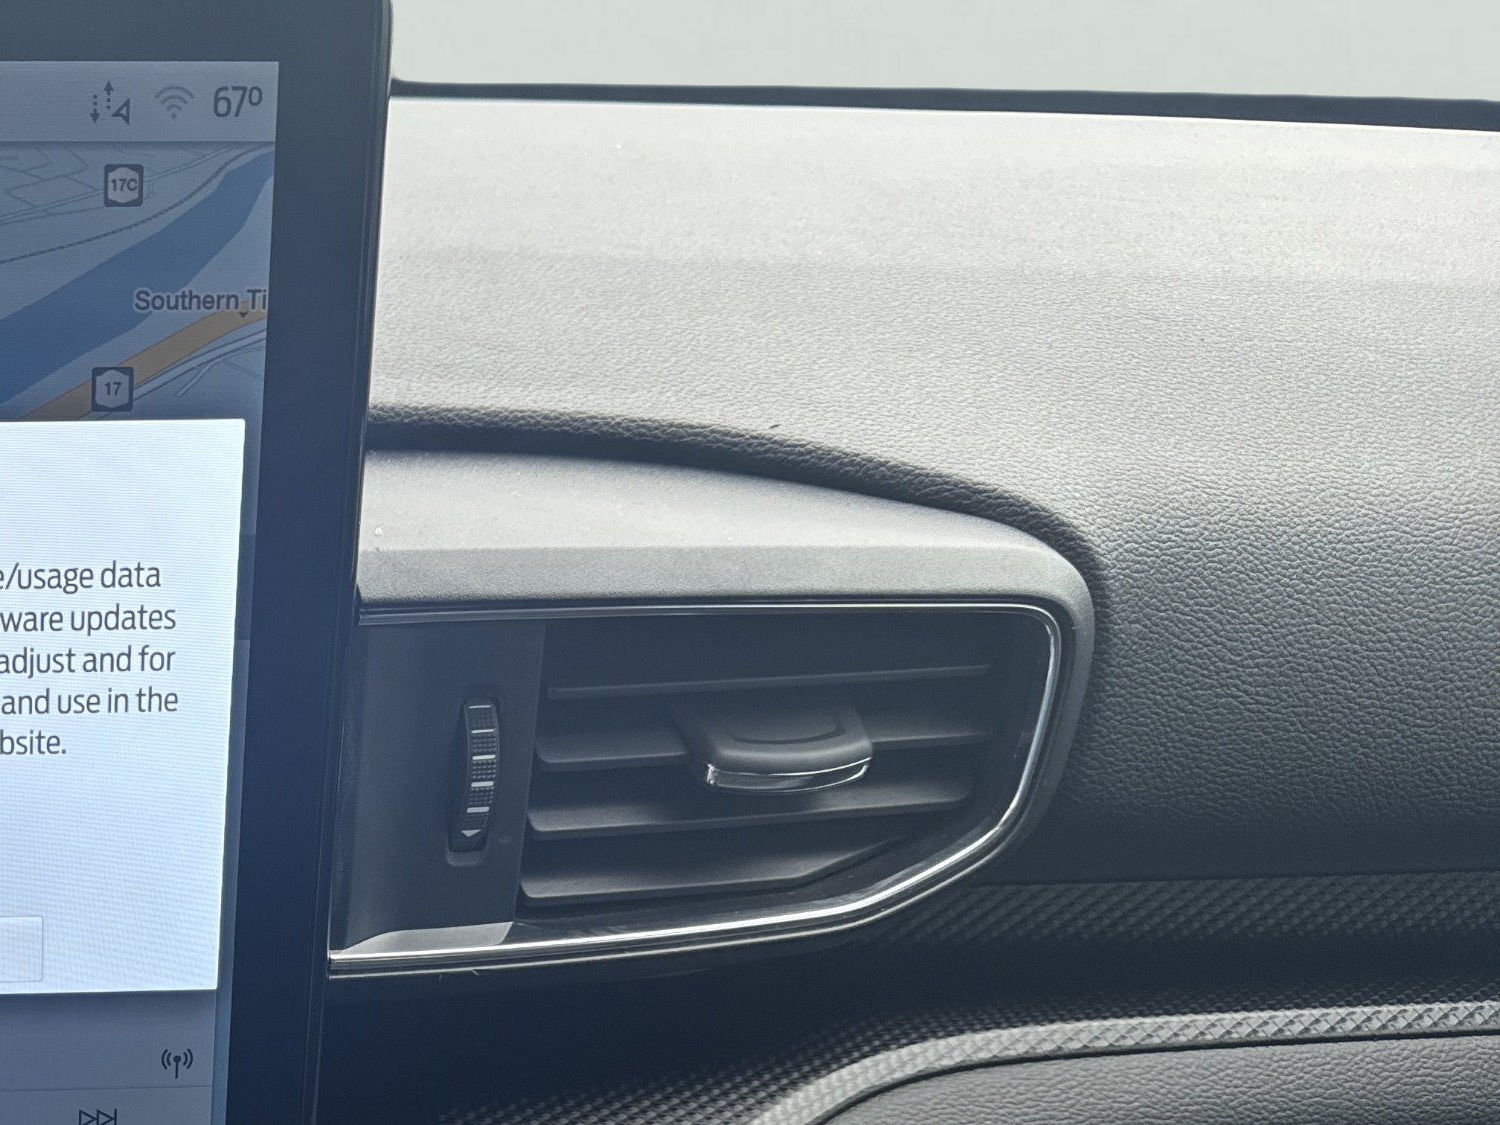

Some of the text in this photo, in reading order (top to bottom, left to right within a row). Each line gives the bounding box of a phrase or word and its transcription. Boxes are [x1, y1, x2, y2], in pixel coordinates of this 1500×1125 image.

[110, 178, 138, 193] 17C
[134, 289, 239, 312] Southern
[103, 381, 122, 397] 17
[100, 560, 162, 589] data
[70, 603, 177, 637] updates
[82, 645, 132, 673] and
[138, 644, 176, 672] for
[1, 688, 50, 715] and
[57, 692, 101, 714] use
[107, 688, 129, 713] in
[135, 686, 179, 713] the
